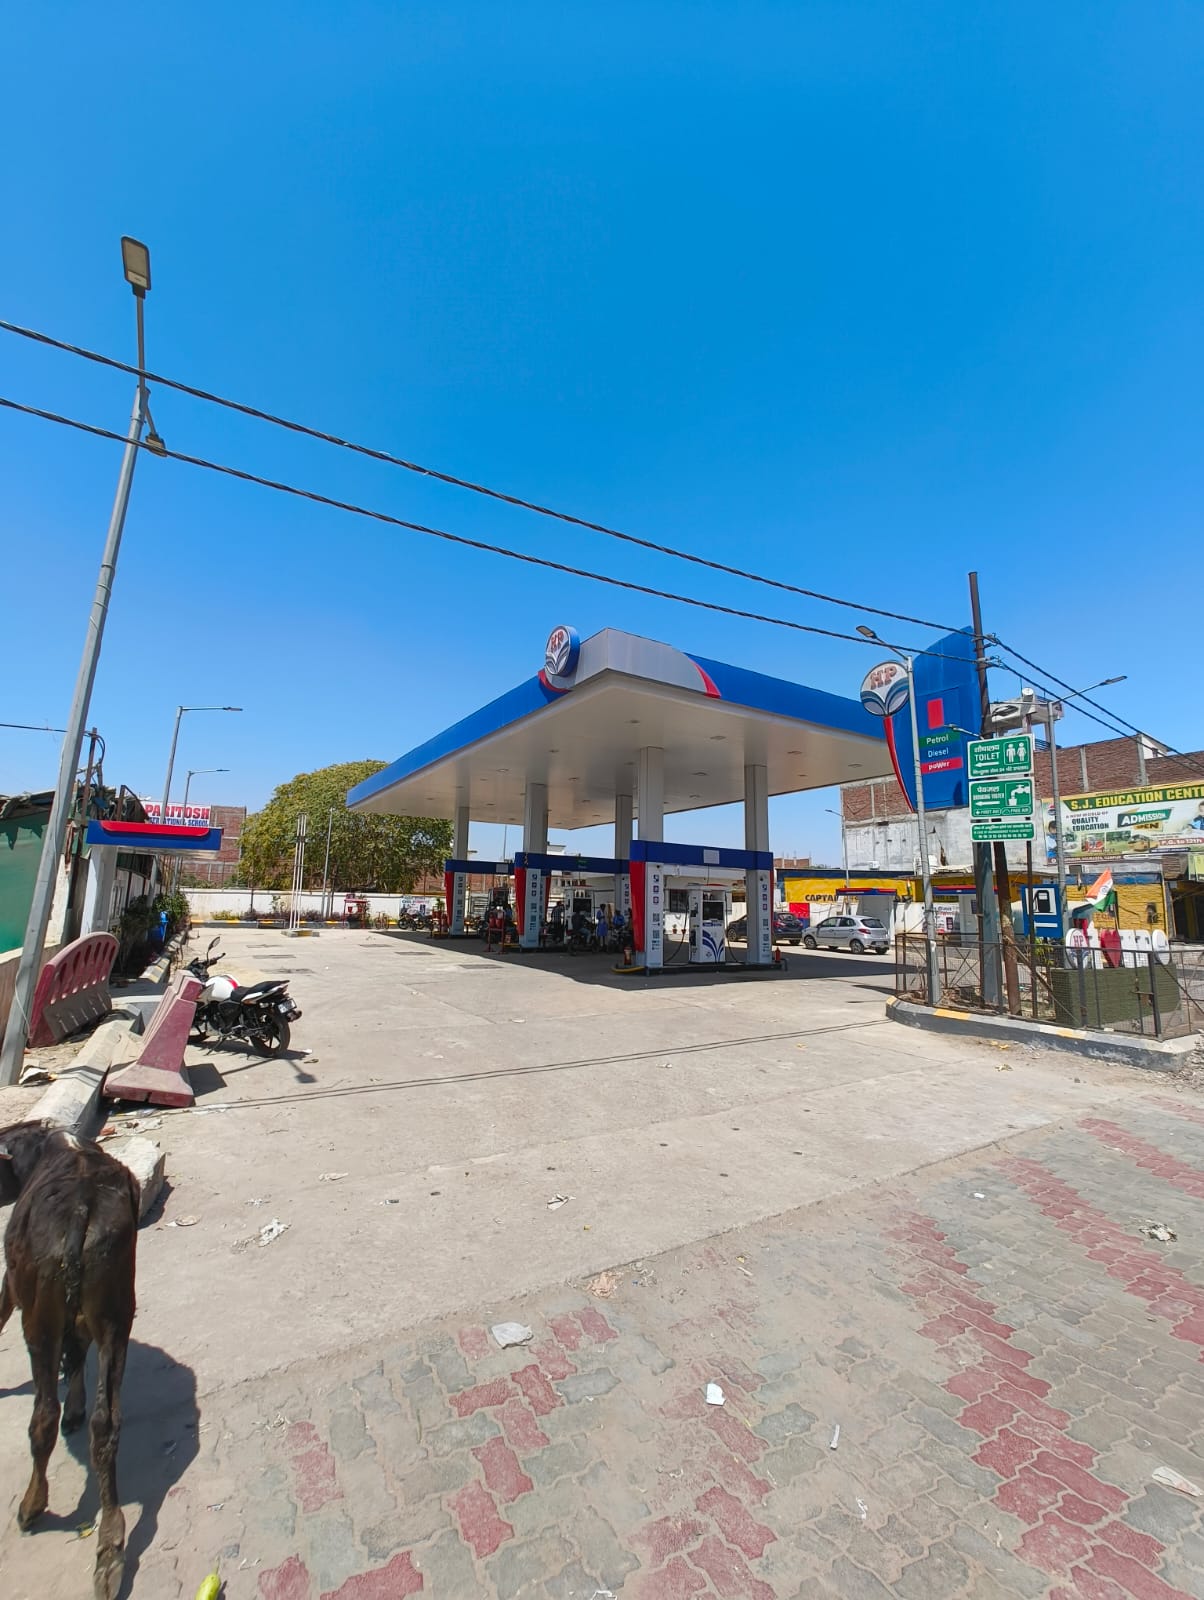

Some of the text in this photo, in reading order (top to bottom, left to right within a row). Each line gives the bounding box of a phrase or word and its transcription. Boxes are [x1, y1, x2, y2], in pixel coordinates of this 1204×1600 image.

[551, 630, 564, 653] HP
[870, 665, 898, 690] HP
[926, 734, 949, 745] Petrol
[927, 747, 949, 758] Diesel
[974, 752, 1000, 762] TOILET
[1071, 799, 1093, 810] S.J.
[1095, 791, 1163, 807] EDUCATION
[1071, 816, 1098, 824] QUALITY
[1072, 823, 1110, 832] EDUCATION
[1072, 934, 1084, 947] HP
